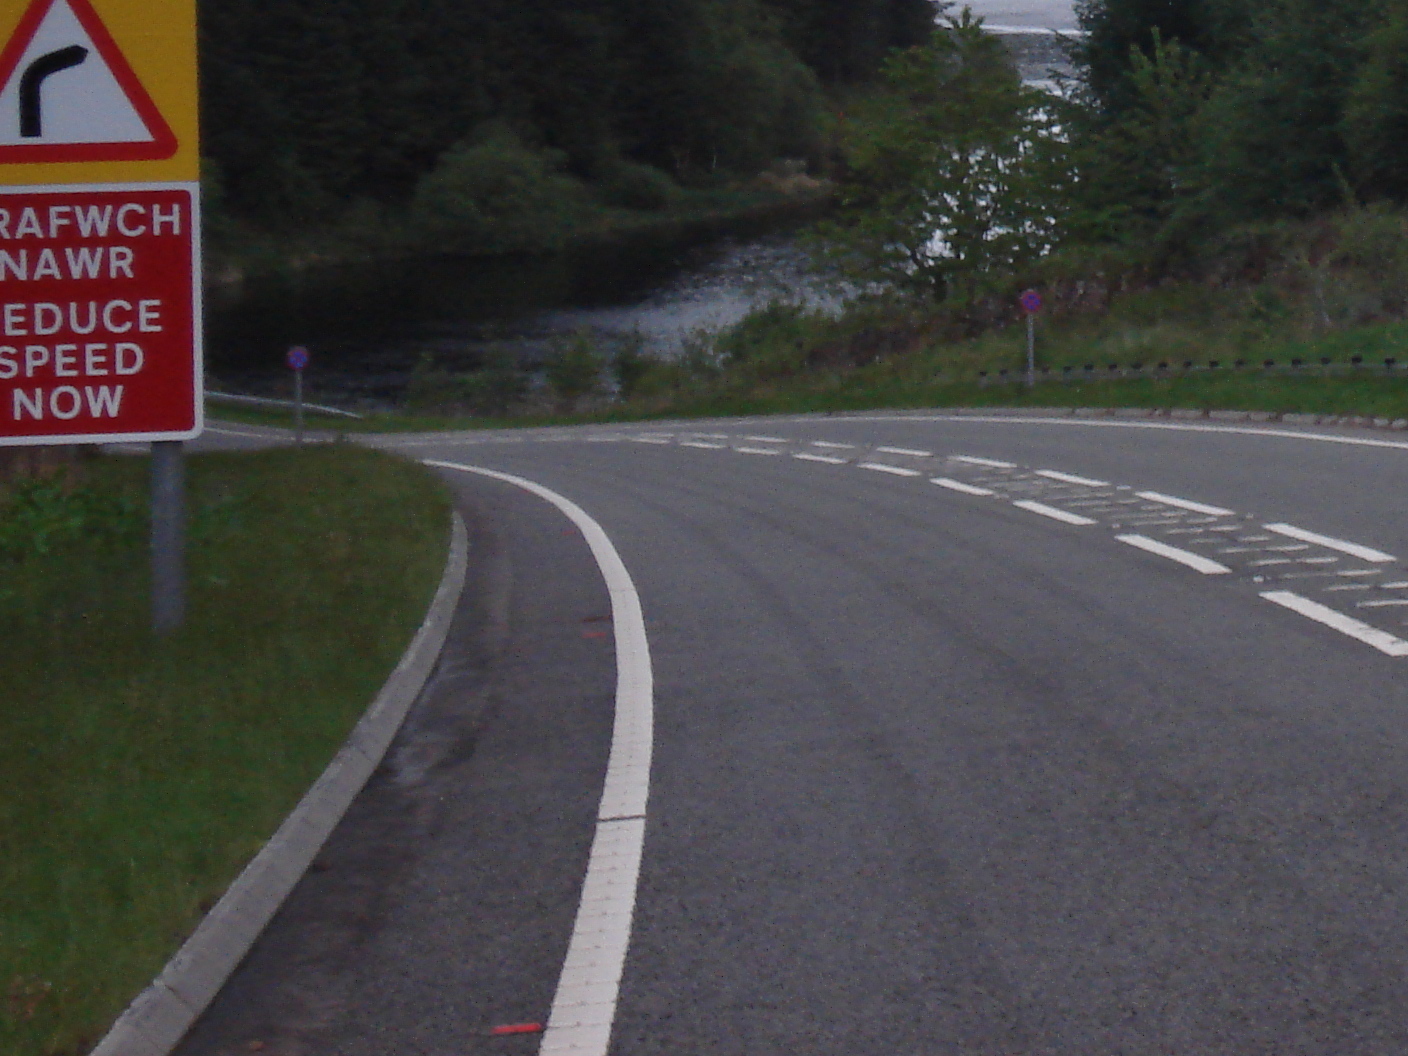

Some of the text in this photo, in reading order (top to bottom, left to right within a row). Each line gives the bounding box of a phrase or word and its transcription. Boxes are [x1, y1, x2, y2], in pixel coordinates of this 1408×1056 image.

[0, 246, 135, 281] NAWR
[3, 299, 163, 337] EDUCE
[0, 342, 144, 380] SPEED
[13, 384, 124, 421] NOW
